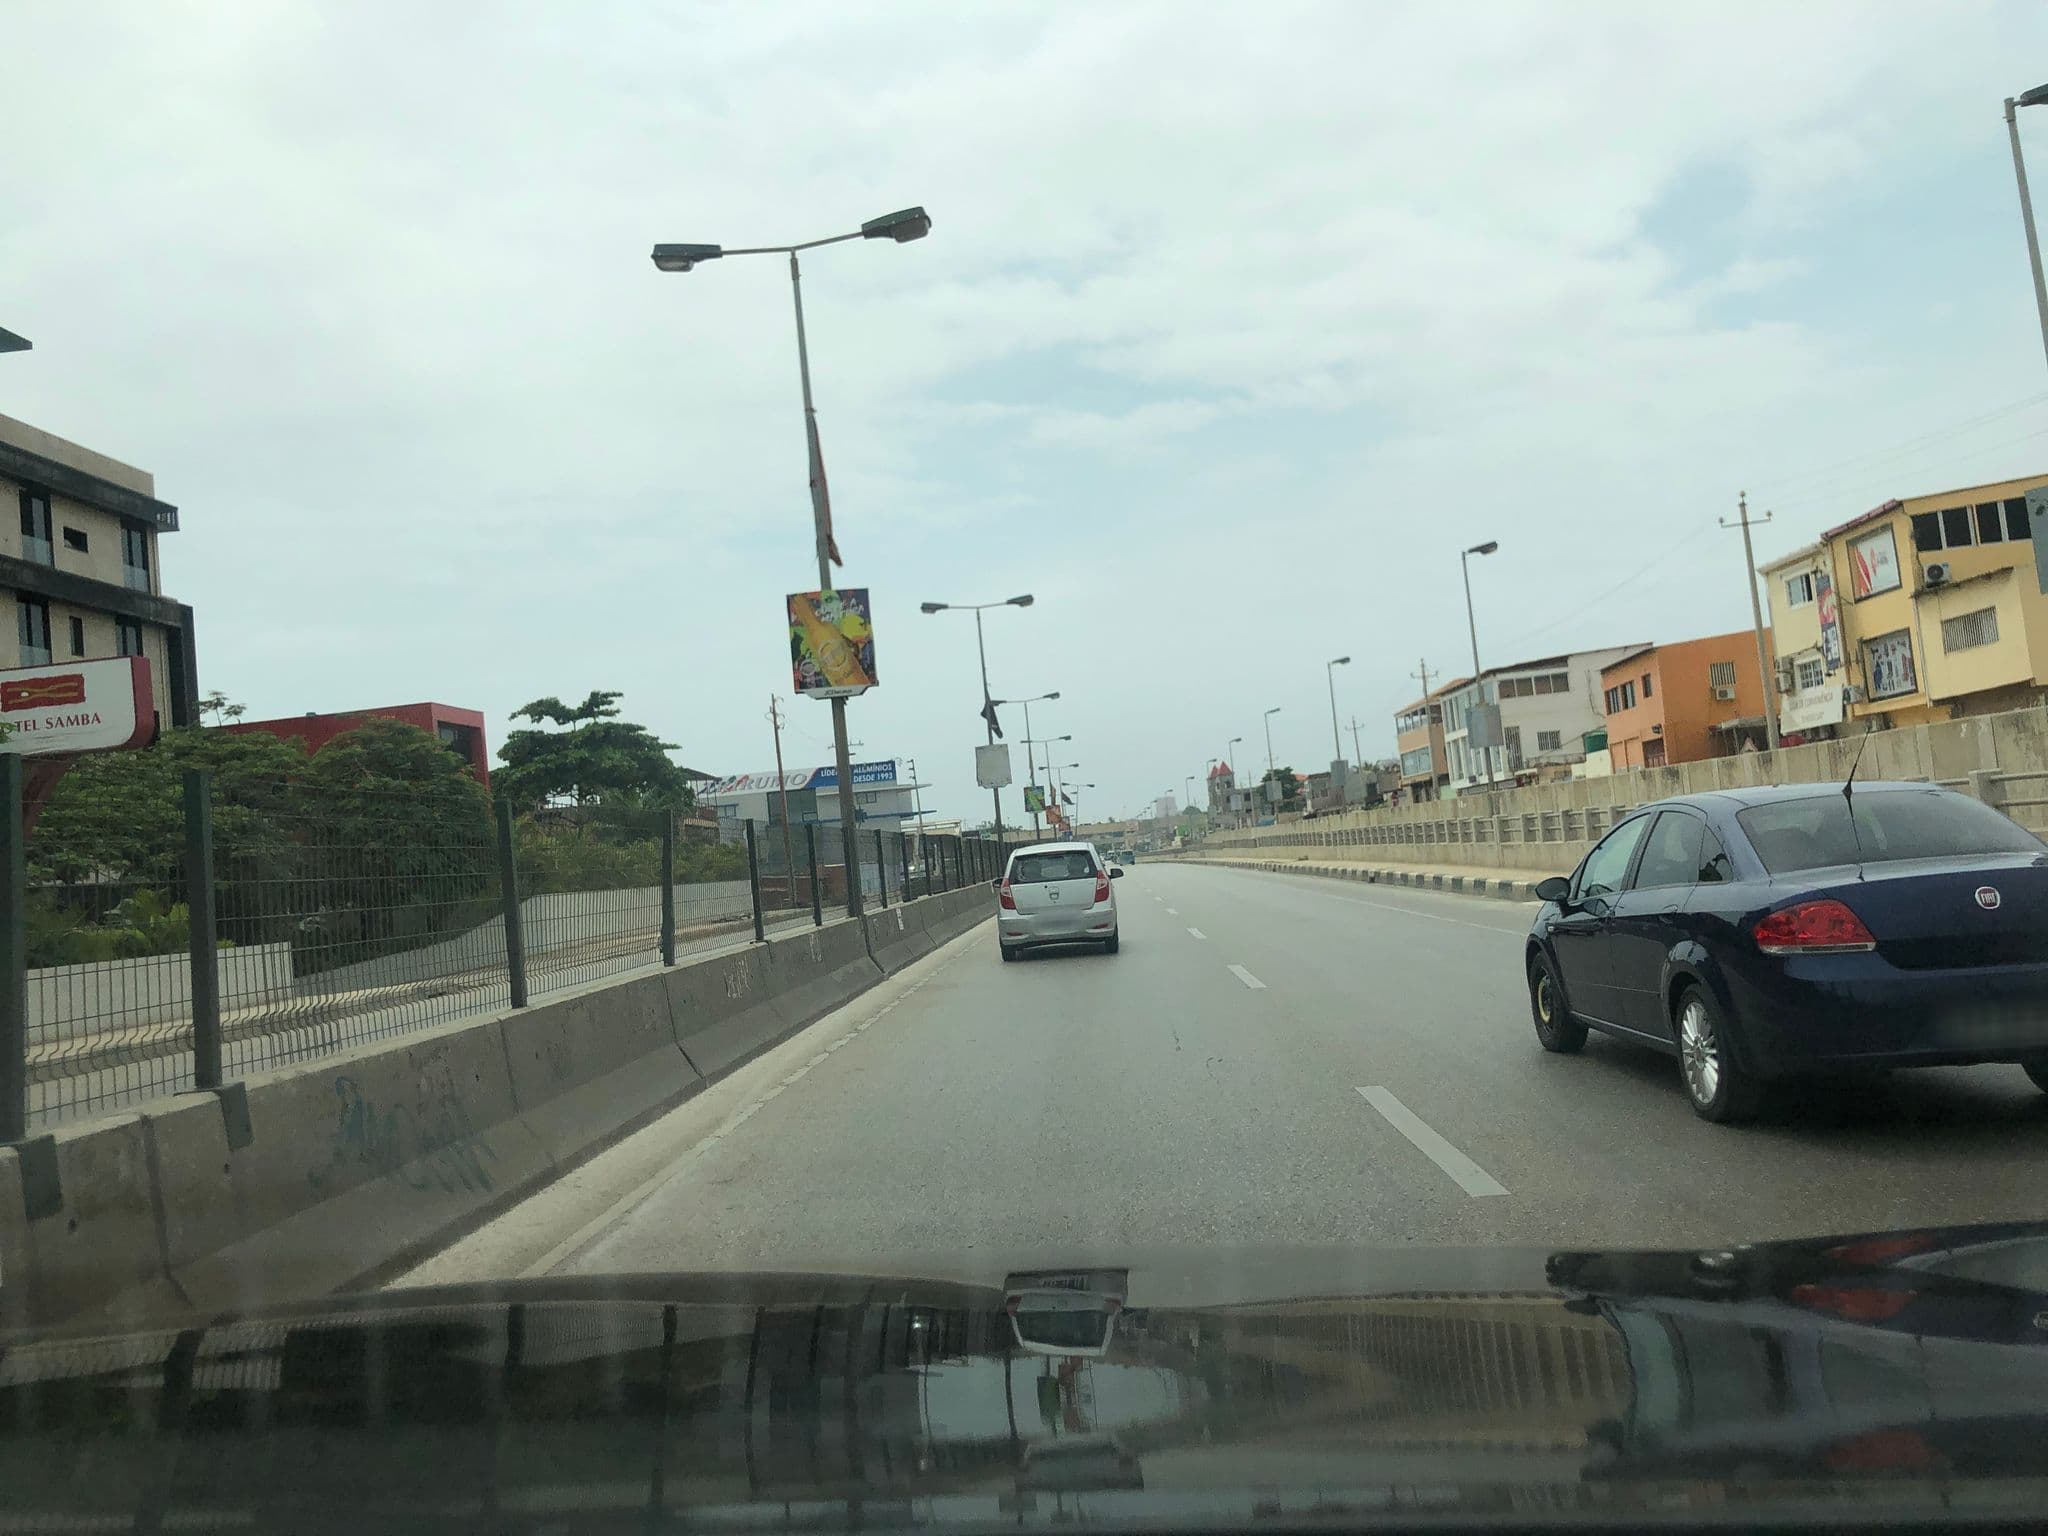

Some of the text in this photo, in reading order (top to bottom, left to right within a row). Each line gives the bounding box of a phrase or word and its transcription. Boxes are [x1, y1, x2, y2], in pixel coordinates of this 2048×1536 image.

[45, 712, 101, 730] SAMBA
[853, 771, 894, 783] DESDE 1993
